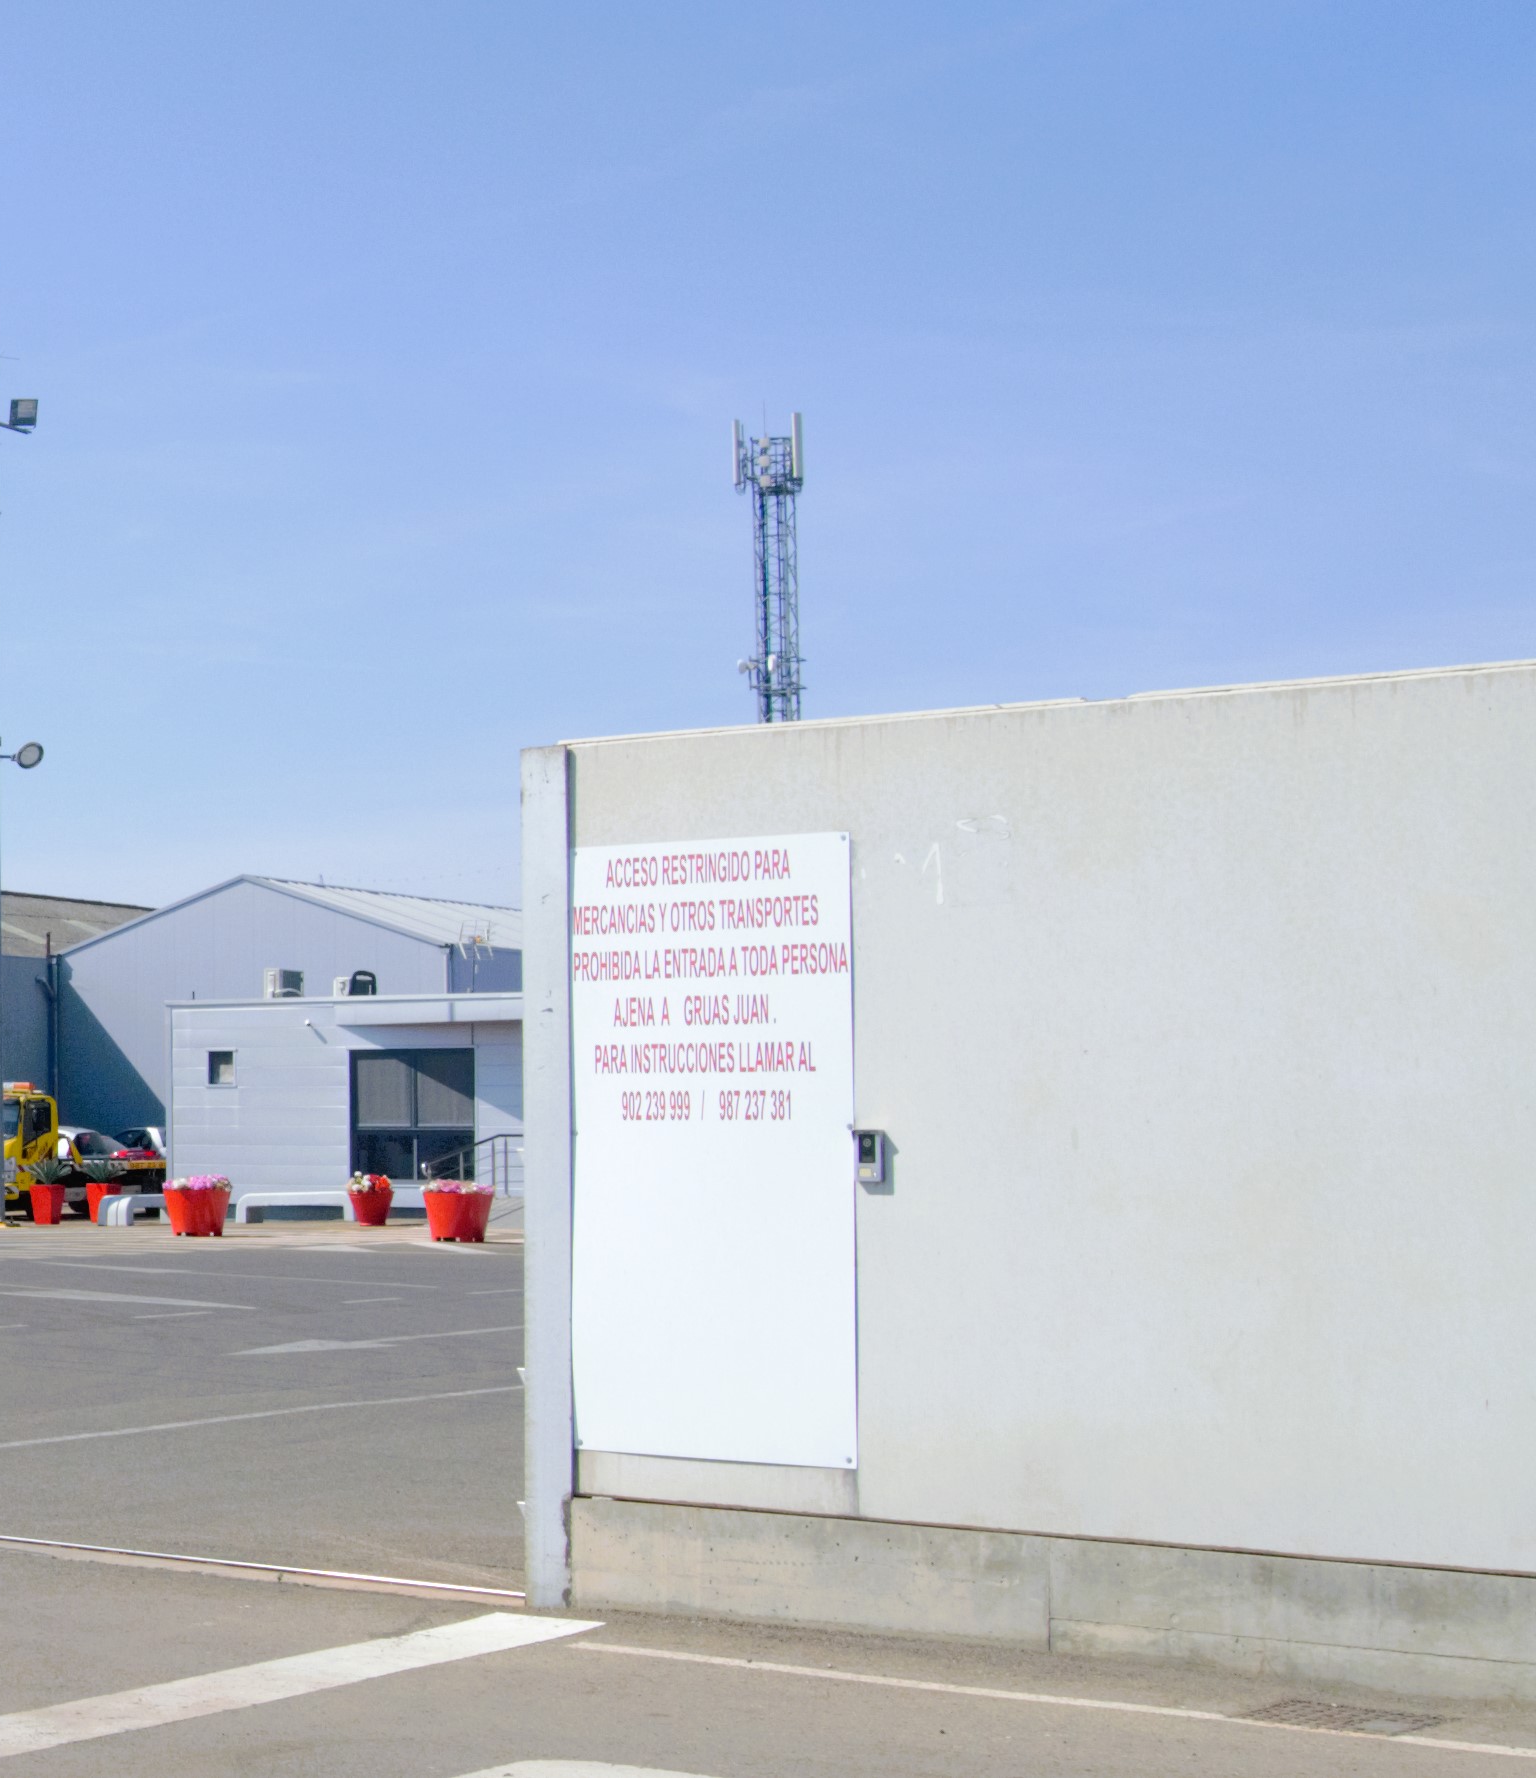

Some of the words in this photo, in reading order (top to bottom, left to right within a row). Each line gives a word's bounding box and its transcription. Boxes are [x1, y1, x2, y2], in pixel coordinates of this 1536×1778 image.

[605, 857, 658, 888] ACCESO
[662, 851, 750, 886] RESTRINGIDO
[755, 849, 791, 880] PARA
[573, 903, 655, 935] MERCANCIAS
[659, 903, 668, 932] Y
[671, 900, 715, 932] OTROS
[719, 895, 819, 929] TRANSPORTES
[573, 950, 641, 982] PROHIBIDA
[645, 949, 661, 979] LA
[664, 947, 726, 979] ENTRADA
[729, 946, 738, 977] A
[741, 945, 778, 976] TODA
[782, 942, 849, 975] PERSONA
[614, 997, 655, 1027] AJENA
[661, 996, 670, 1026] A
[684, 994, 729, 1026] GRUAS
[733, 994, 769, 1025] JUAN
[595, 1044, 628, 1074] PARA
[631, 1042, 735, 1074] INSTRUCCIONES
[739, 1041, 795, 1073] LLAMAR
[798, 1040, 817, 1072] AL
[621, 1091, 642, 1121] 902
[645, 1090, 666, 1121] 239
[670, 1090, 691, 1120] 999
[719, 1090, 741, 1120] 987
[744, 1090, 766, 1120] 237
[770, 1089, 792, 1120] 381
